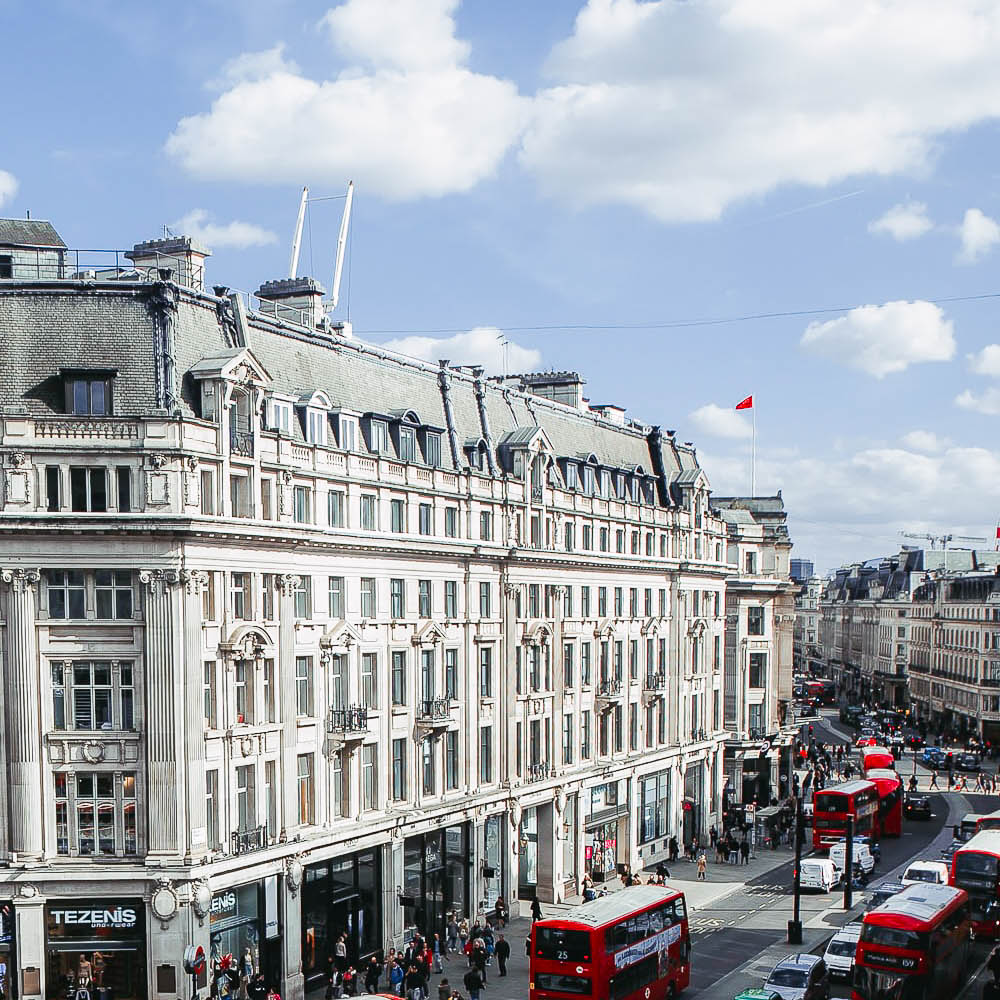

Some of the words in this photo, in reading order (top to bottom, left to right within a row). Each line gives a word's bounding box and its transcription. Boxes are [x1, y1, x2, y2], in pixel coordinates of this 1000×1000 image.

[209, 892, 236, 911] ENIS
[50, 907, 136, 924] TEZENIS
[557, 950, 568, 959] 25
